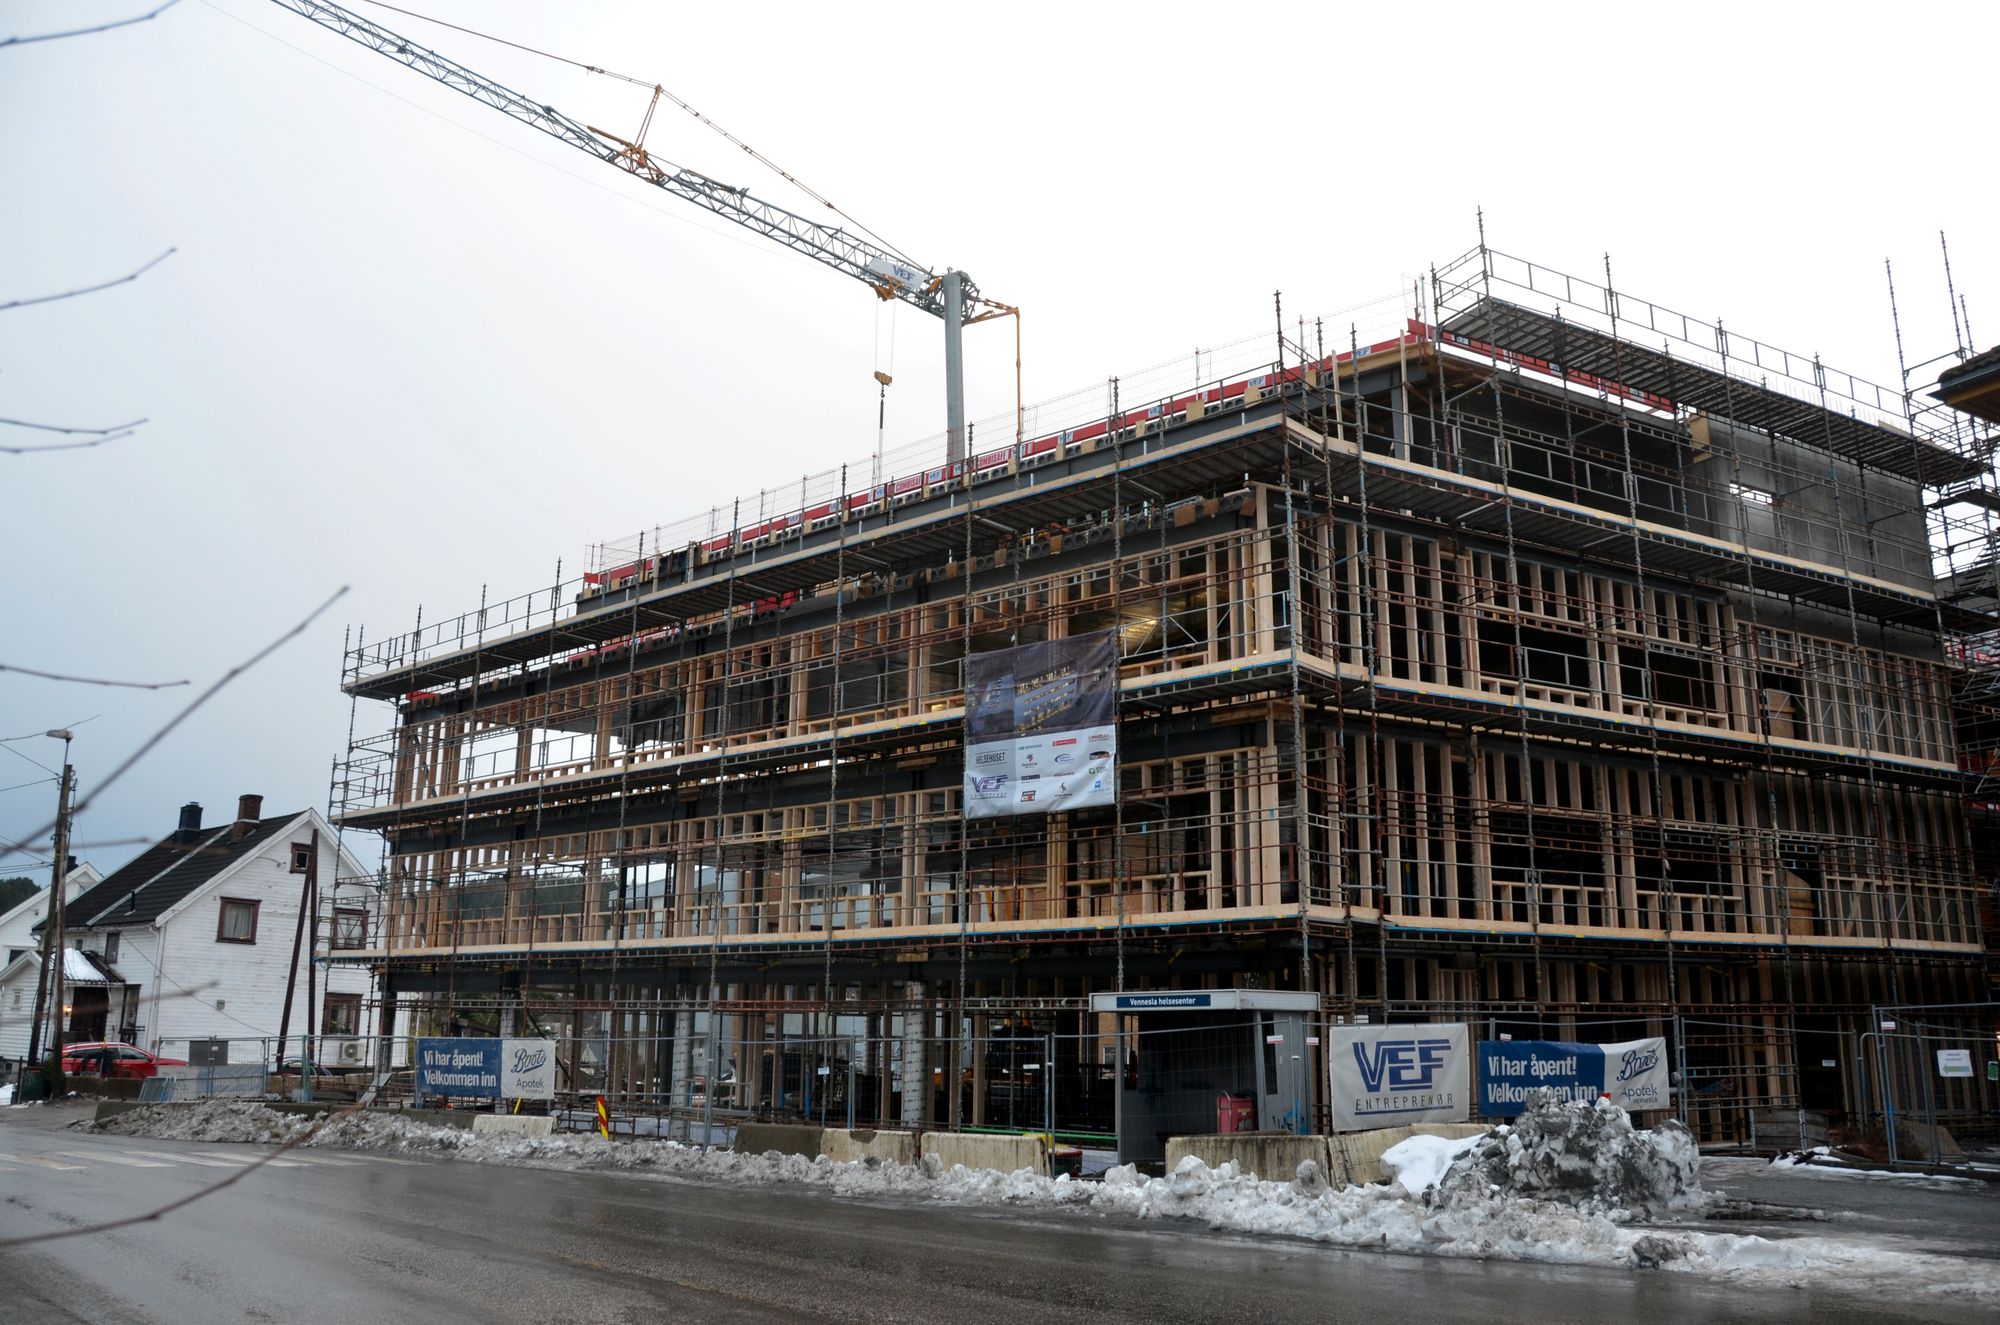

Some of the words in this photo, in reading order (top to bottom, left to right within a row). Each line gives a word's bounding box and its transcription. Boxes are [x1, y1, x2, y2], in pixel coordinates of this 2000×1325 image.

[893, 264, 915, 281] VEF
[978, 450, 1007, 468] OMBISAFE
[971, 774, 1009, 793] VEF
[1129, 997, 1158, 1006] Vennesla
[1159, 997, 1196, 1006] helsesenter
[424, 1050, 434, 1065] Vi
[435, 1050, 451, 1066] har
[452, 1049, 483, 1069] åpent!
[511, 1048, 546, 1074] Boots
[1352, 1039, 1452, 1093] VEF
[1488, 1056, 1500, 1077] Vi
[1501, 1056, 1528, 1077] har
[1530, 1053, 1577, 1080] åpent!
[424, 1070, 479, 1087] Velkommen
[481, 1071, 497, 1087] inn
[516, 1078, 545, 1090] Apotek
[1574, 1082, 1598, 1102] inn
[1621, 1083, 1658, 1101] Apotek
[1355, 1093, 1454, 1112] ENTREPRENØR
